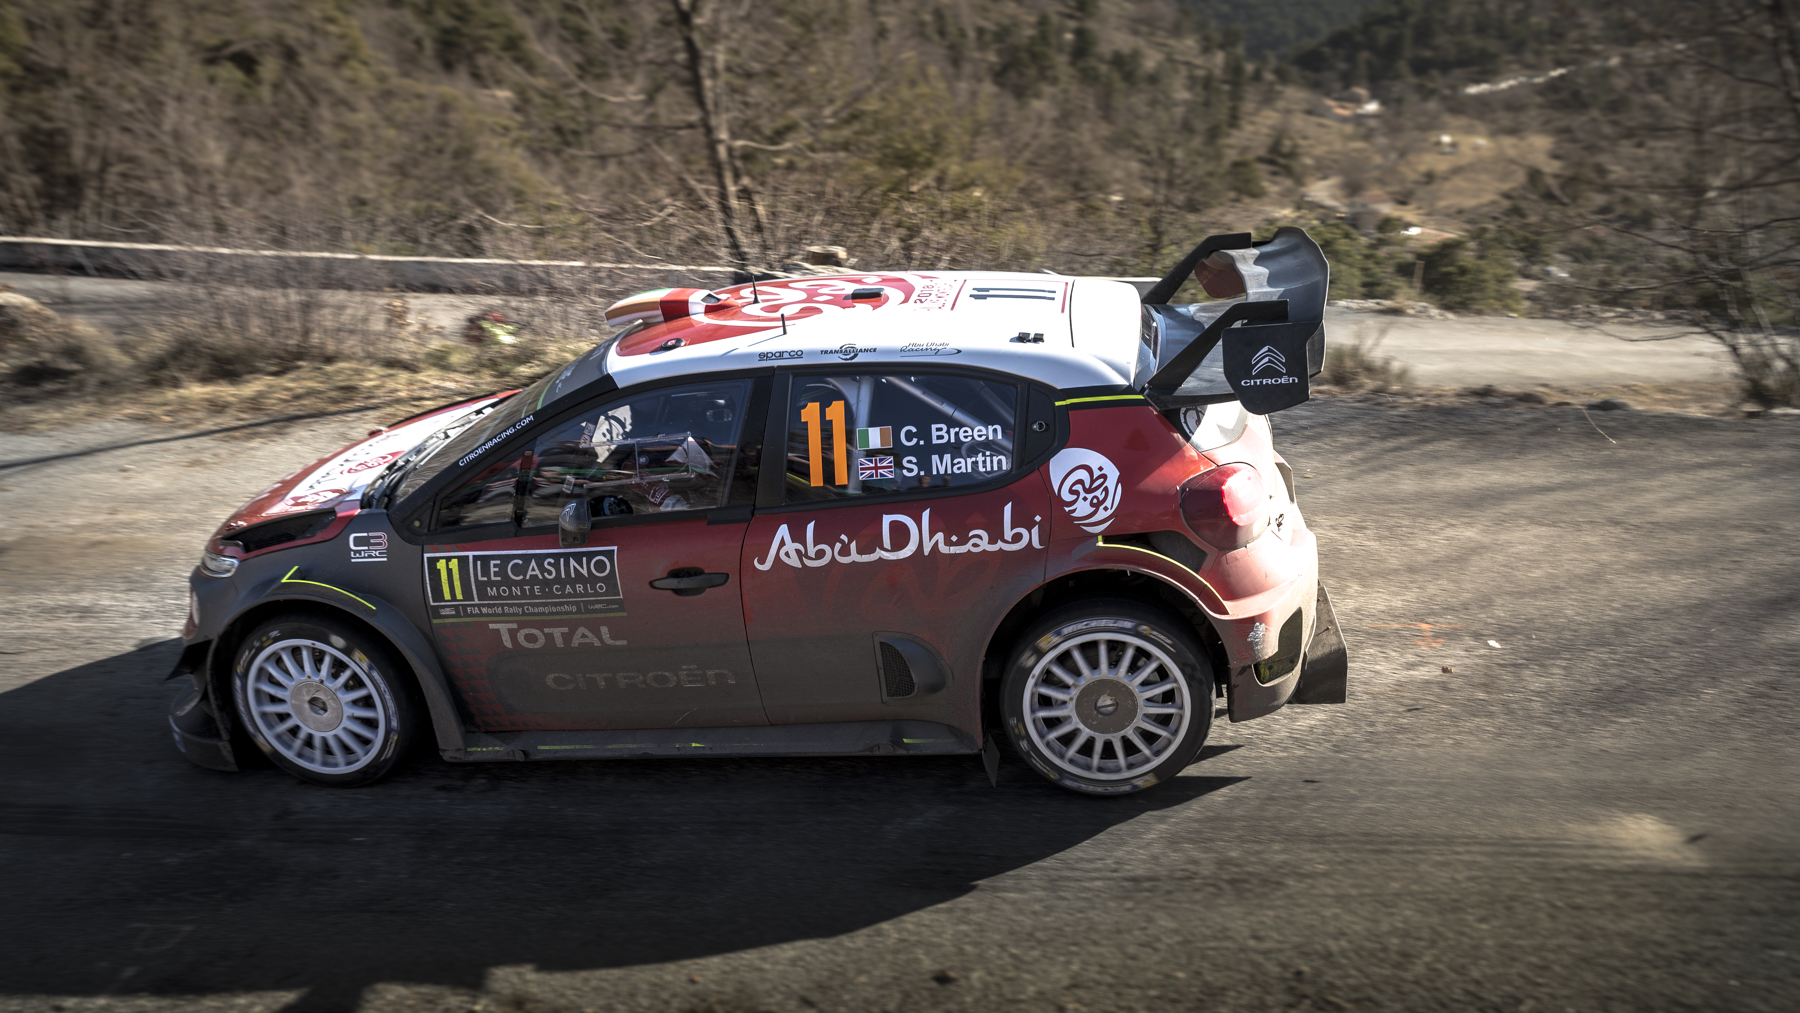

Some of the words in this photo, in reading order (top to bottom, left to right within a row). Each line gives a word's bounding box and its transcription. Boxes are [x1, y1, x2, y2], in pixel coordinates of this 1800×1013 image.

[758, 349, 804, 361] sparco
[819, 347, 878, 355] TRANSALLIANCE
[458, 414, 535, 467] CITROENRACING.COM
[800, 400, 848, 487] 11
[900, 425, 925, 447] C.
[931, 423, 1003, 444] Breen
[902, 455, 925, 477] S.
[931, 450, 1007, 475] Martin
[348, 531, 389, 550] C3
[350, 550, 388, 558] WRC
[436, 558, 464, 600] 11
[476, 560, 502, 581] LE
[507, 555, 611, 580] CASINO
[467, 606, 480, 614] FIA
[481, 605, 502, 614] World
[504, 604, 522, 615] Rally
[524, 602, 577, 614] Championship
[488, 622, 628, 649] TOTAL
